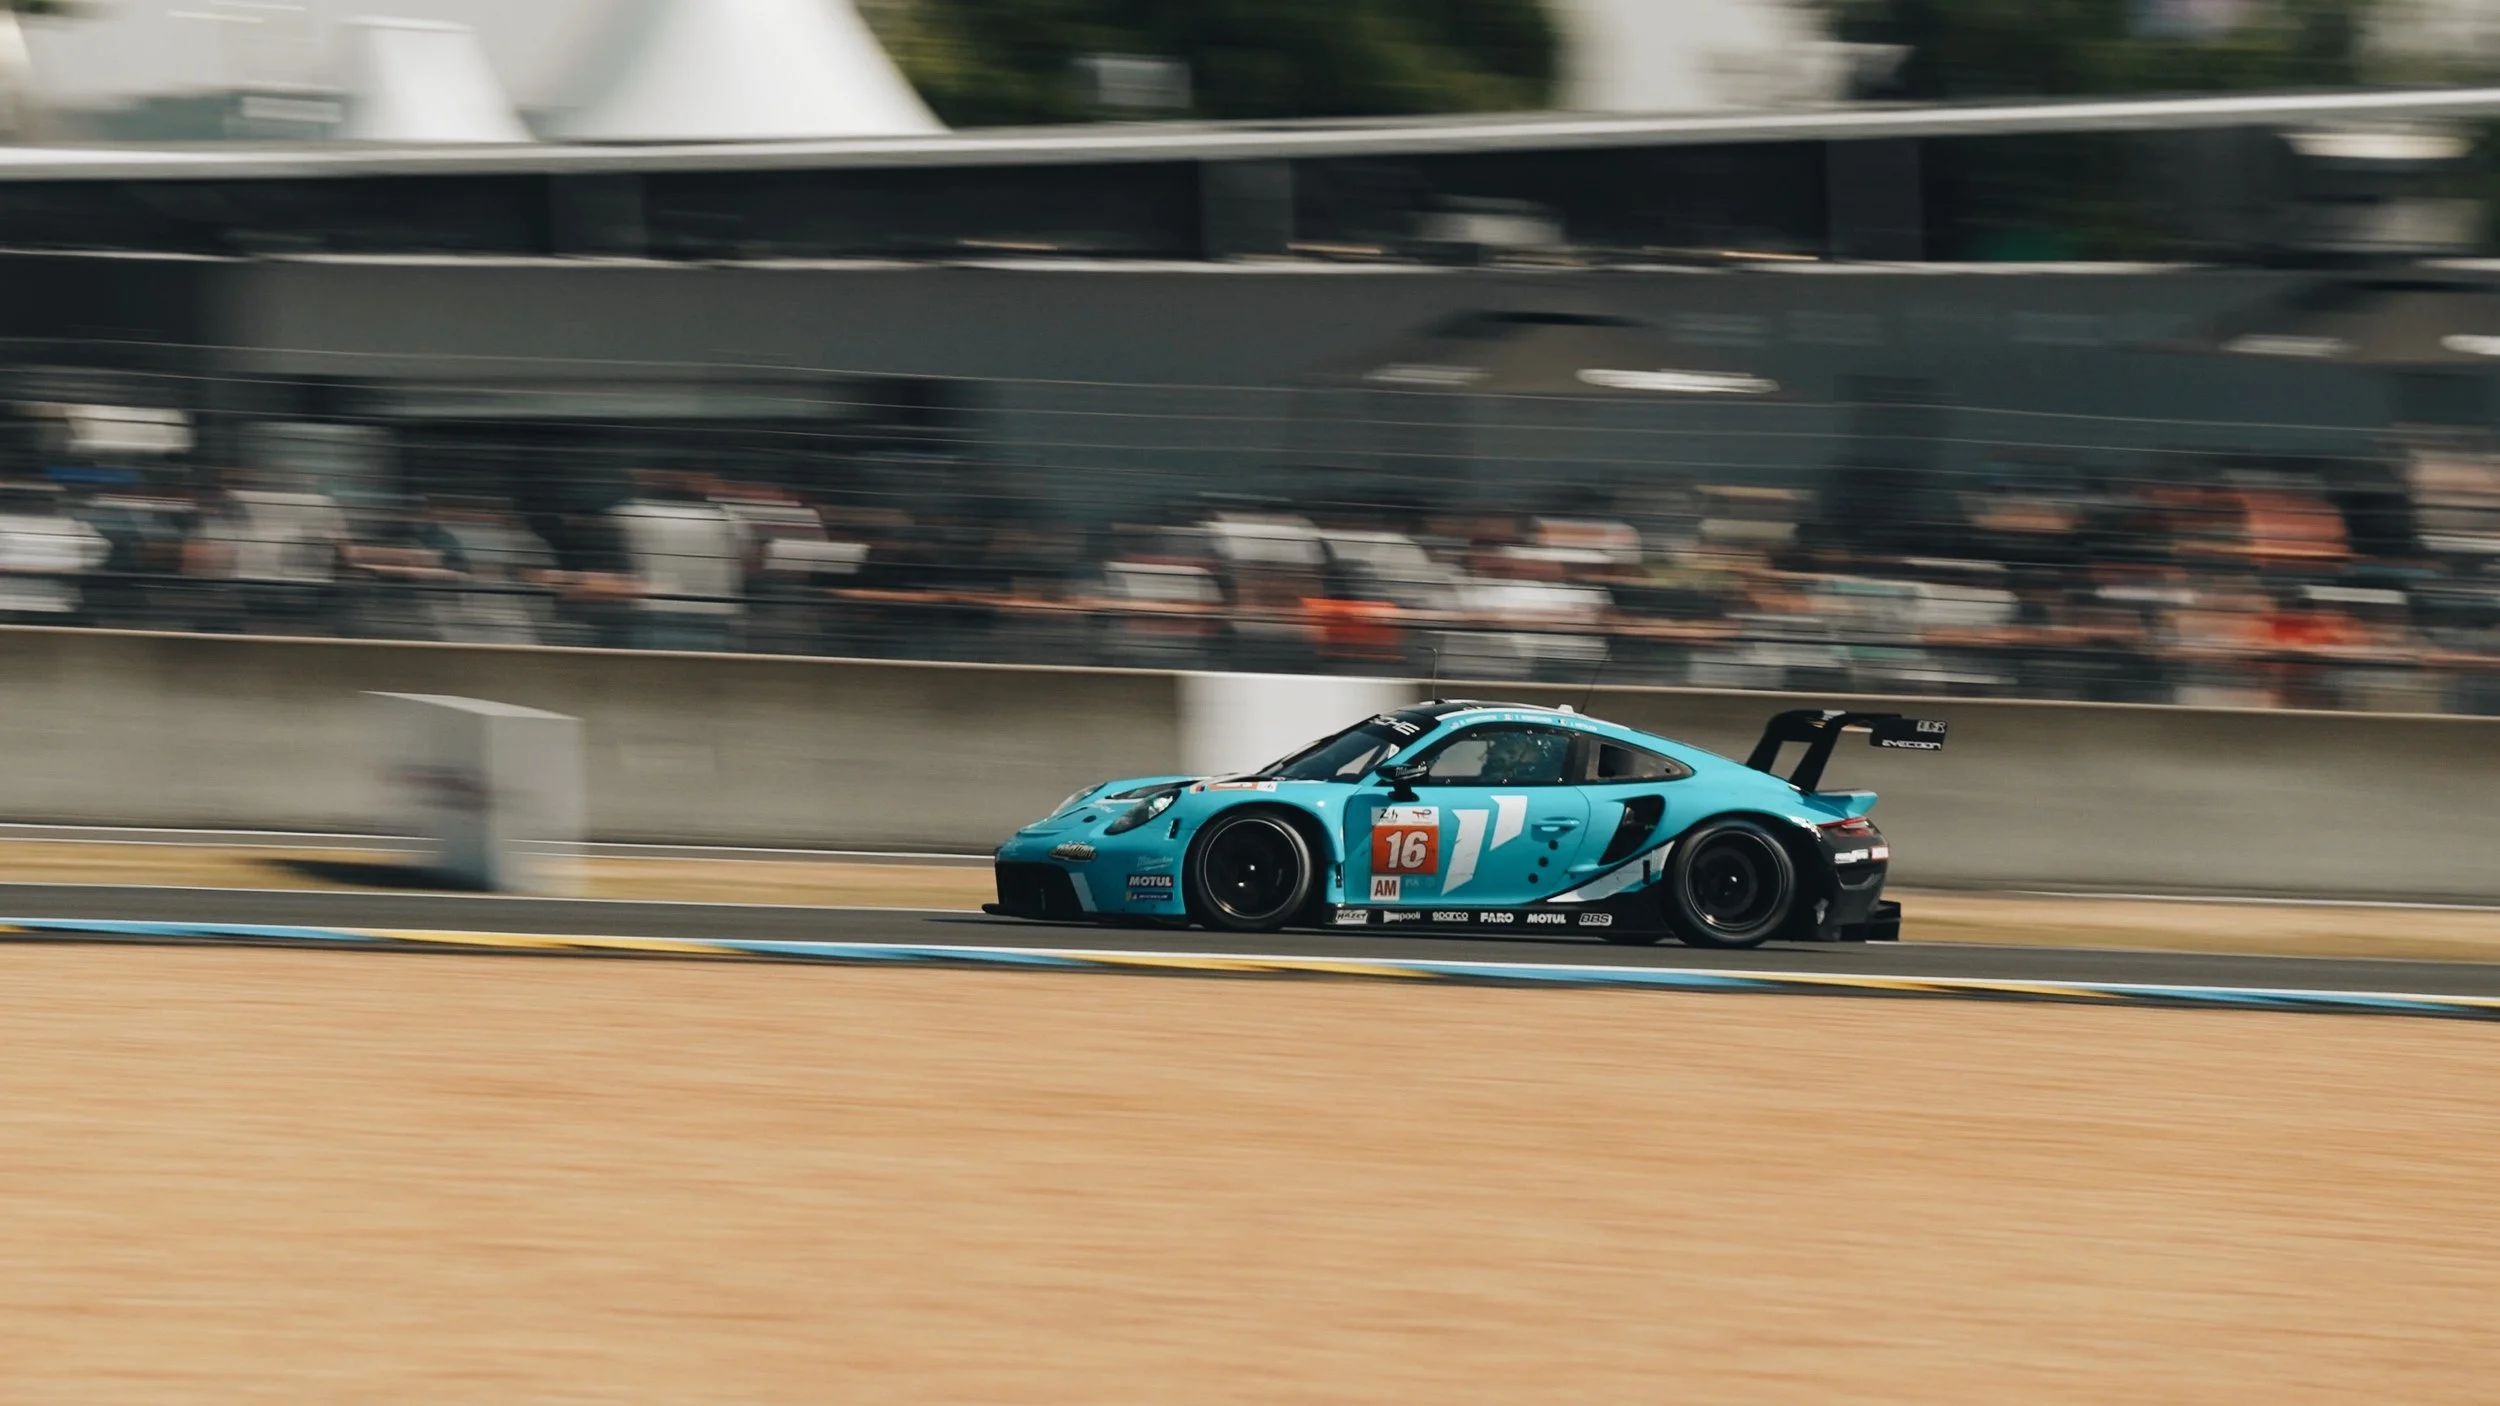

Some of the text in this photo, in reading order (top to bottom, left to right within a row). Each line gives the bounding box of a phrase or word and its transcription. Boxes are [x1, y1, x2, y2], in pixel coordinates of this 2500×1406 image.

[1386, 830, 1429, 869] 16
[1129, 876, 1172, 887] MOTUL
[1375, 880, 1397, 896] AM
[1432, 911, 1469, 922] sparco
[1480, 912, 1514, 923] FARO
[1527, 914, 1566, 924] MOTUL
[1579, 913, 1612, 926] BBS
